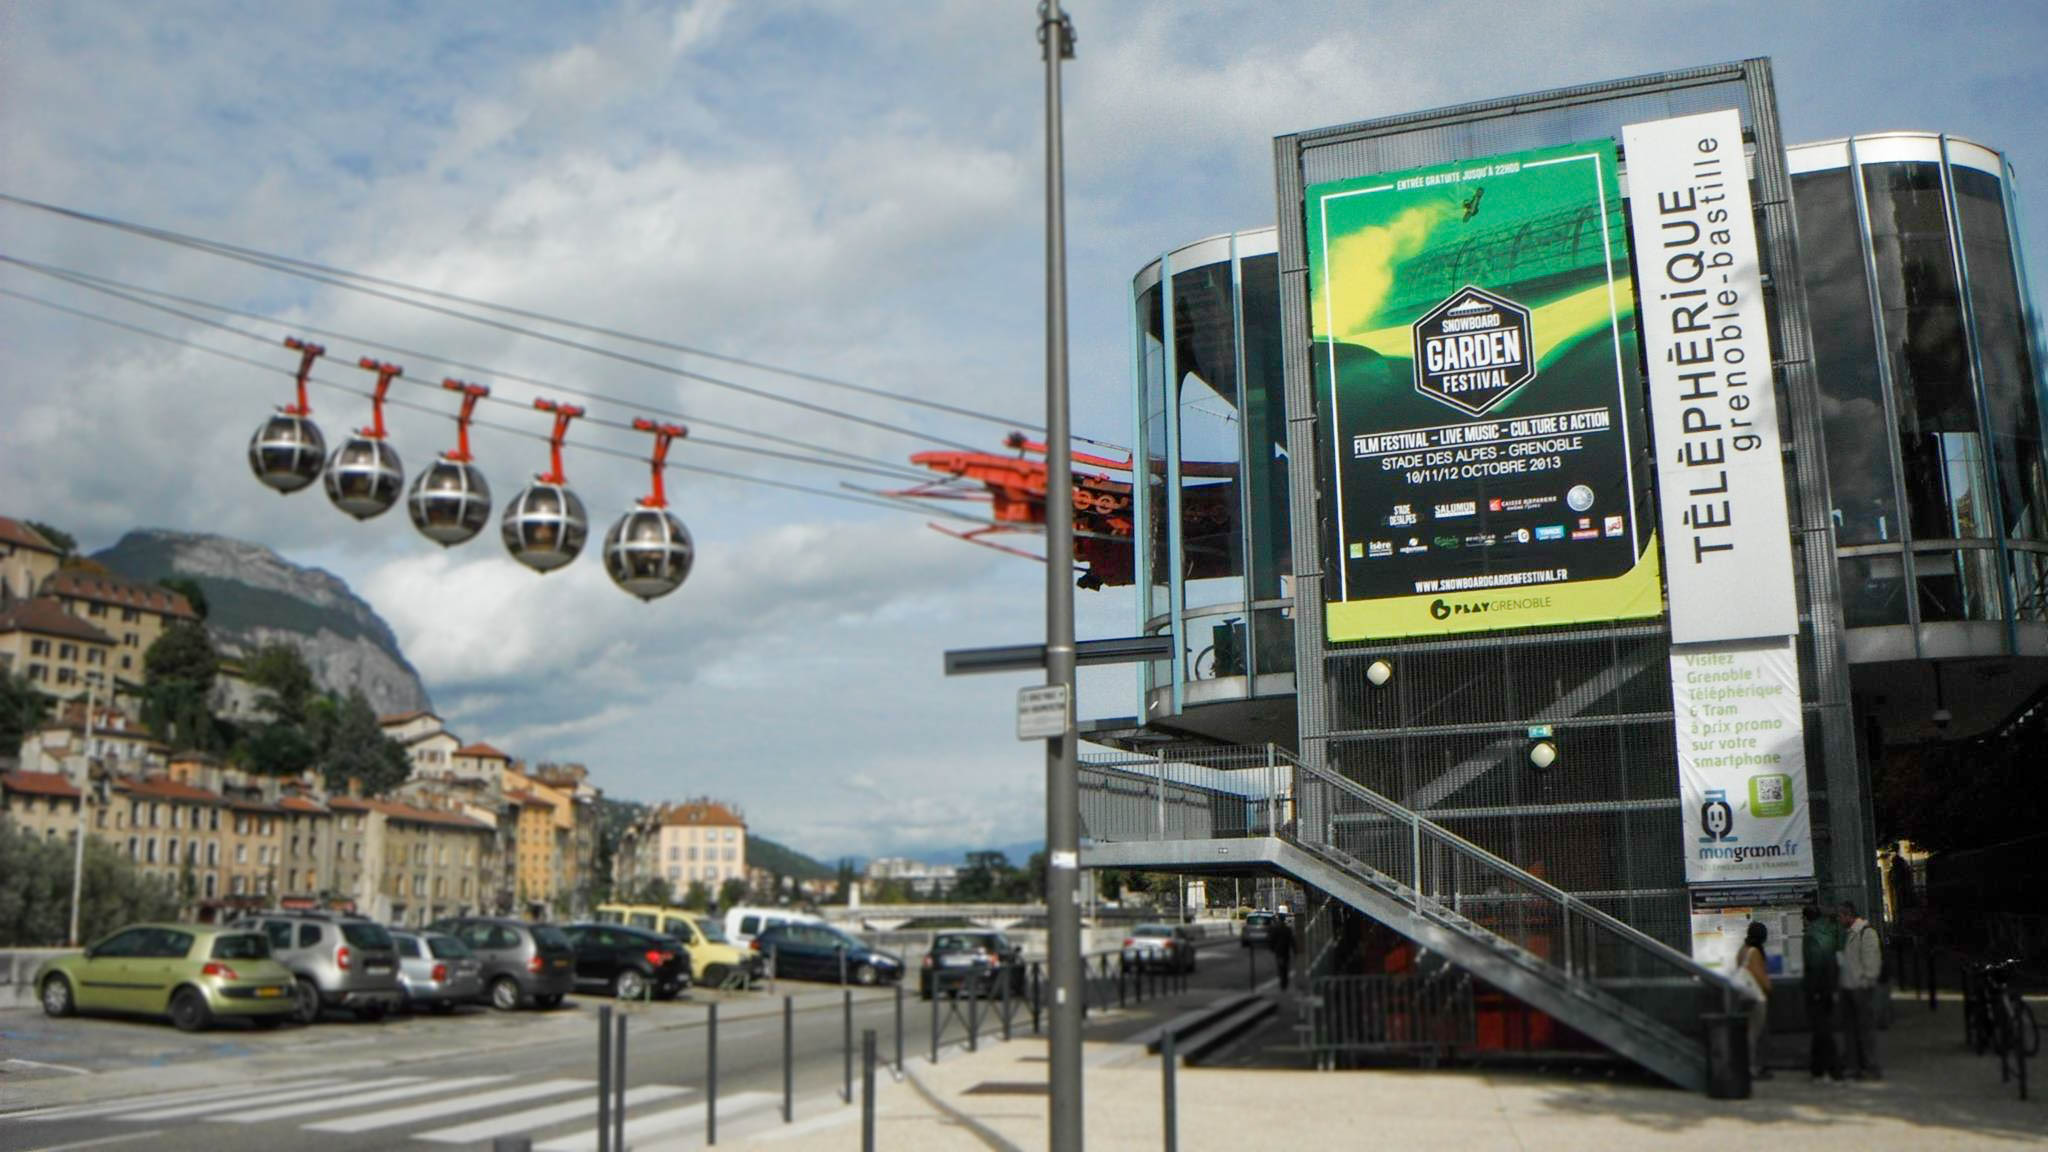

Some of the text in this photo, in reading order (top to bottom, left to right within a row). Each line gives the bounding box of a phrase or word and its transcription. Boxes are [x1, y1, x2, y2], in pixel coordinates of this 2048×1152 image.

[1694, 137, 1761, 451] grenoble-bastille
[1442, 313, 1500, 333] SNOWBOARD
[1426, 329, 1520, 372] GARDEN
[1442, 369, 1509, 393] FESTIVAL
[1354, 438, 1379, 454] FILM
[1381, 432, 1429, 451] FESTIVAL
[1440, 427, 1464, 445] LIVE
[1465, 424, 1499, 442] MUSIC
[1510, 416, 1558, 437] CULTURE
[1560, 416, 1568, 431] &
[1570, 411, 1610, 430] ACTION
[1382, 454, 1423, 470] STADE
[1426, 451, 1453, 466] DES
[1455, 446, 1497, 463] ALPES
[1508, 436, 1584, 457] GRENOBLE
[1406, 456, 1561, 484] 10/11/12 OCTOBRE 2013
[1434, 501, 1476, 515] SALOMON
[1415, 568, 1568, 593] WWW.SNOWBOARDGARDENFESTIVAL.FR
[1685, 654, 1734, 666] Visitez
[1687, 668, 1752, 684] Grenoble
[1688, 684, 1783, 701] Téléphérique
[1702, 704, 1738, 716] Tram
[1703, 720, 1729, 737] prix
[1735, 718, 1783, 734] promo
[1692, 737, 1757, 751] sur votre
[1694, 752, 1781, 769] smartphone
[1699, 840, 1798, 862] mongroom.fr
